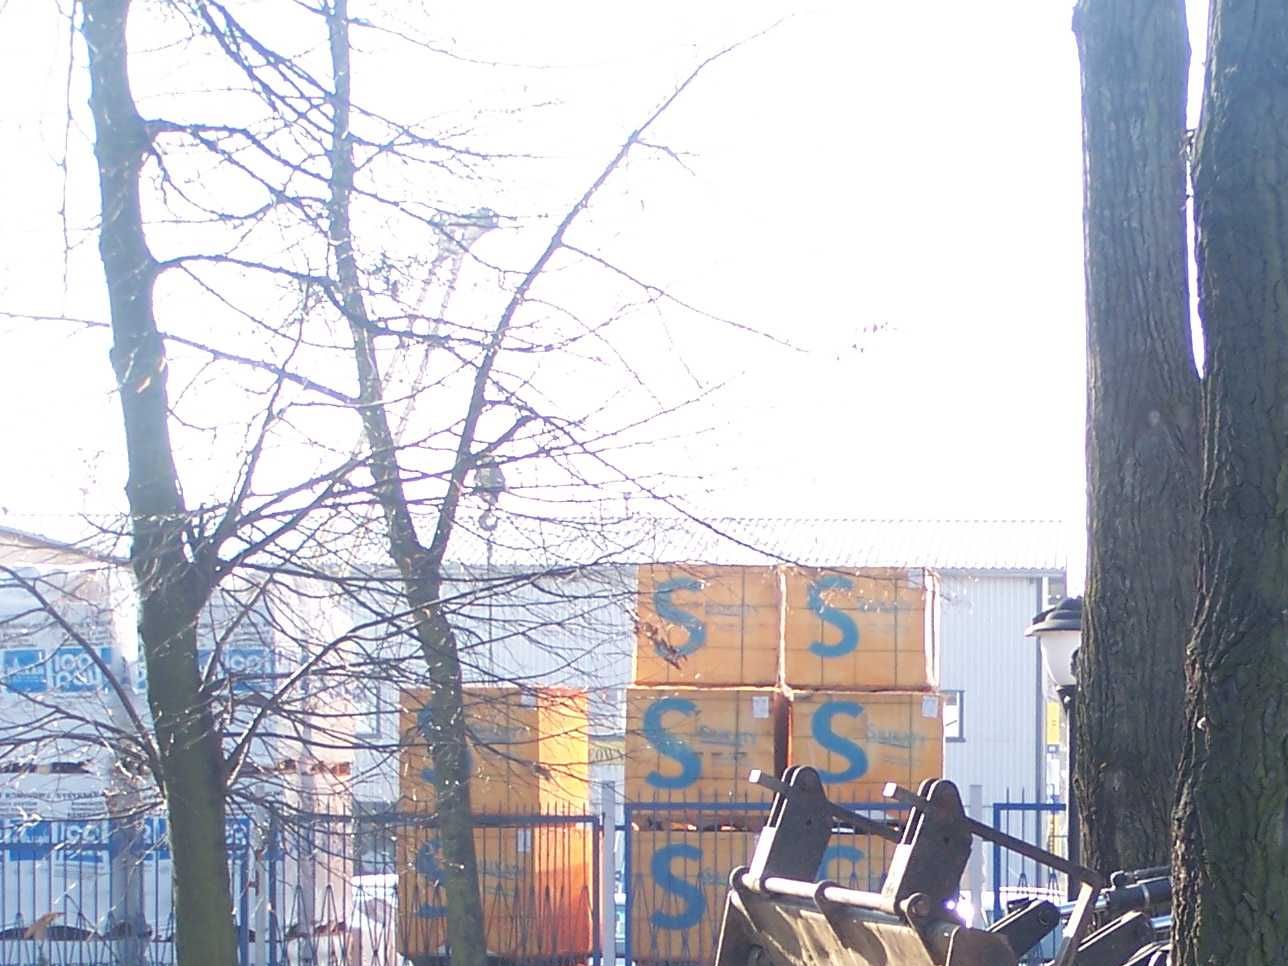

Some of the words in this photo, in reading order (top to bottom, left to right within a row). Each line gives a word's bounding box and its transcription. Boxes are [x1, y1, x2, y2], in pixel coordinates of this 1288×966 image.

[654, 576, 706, 657] S
[807, 575, 859, 657] S
[643, 698, 702, 789] S
[812, 700, 869, 784] S
[651, 842, 706, 929] S
